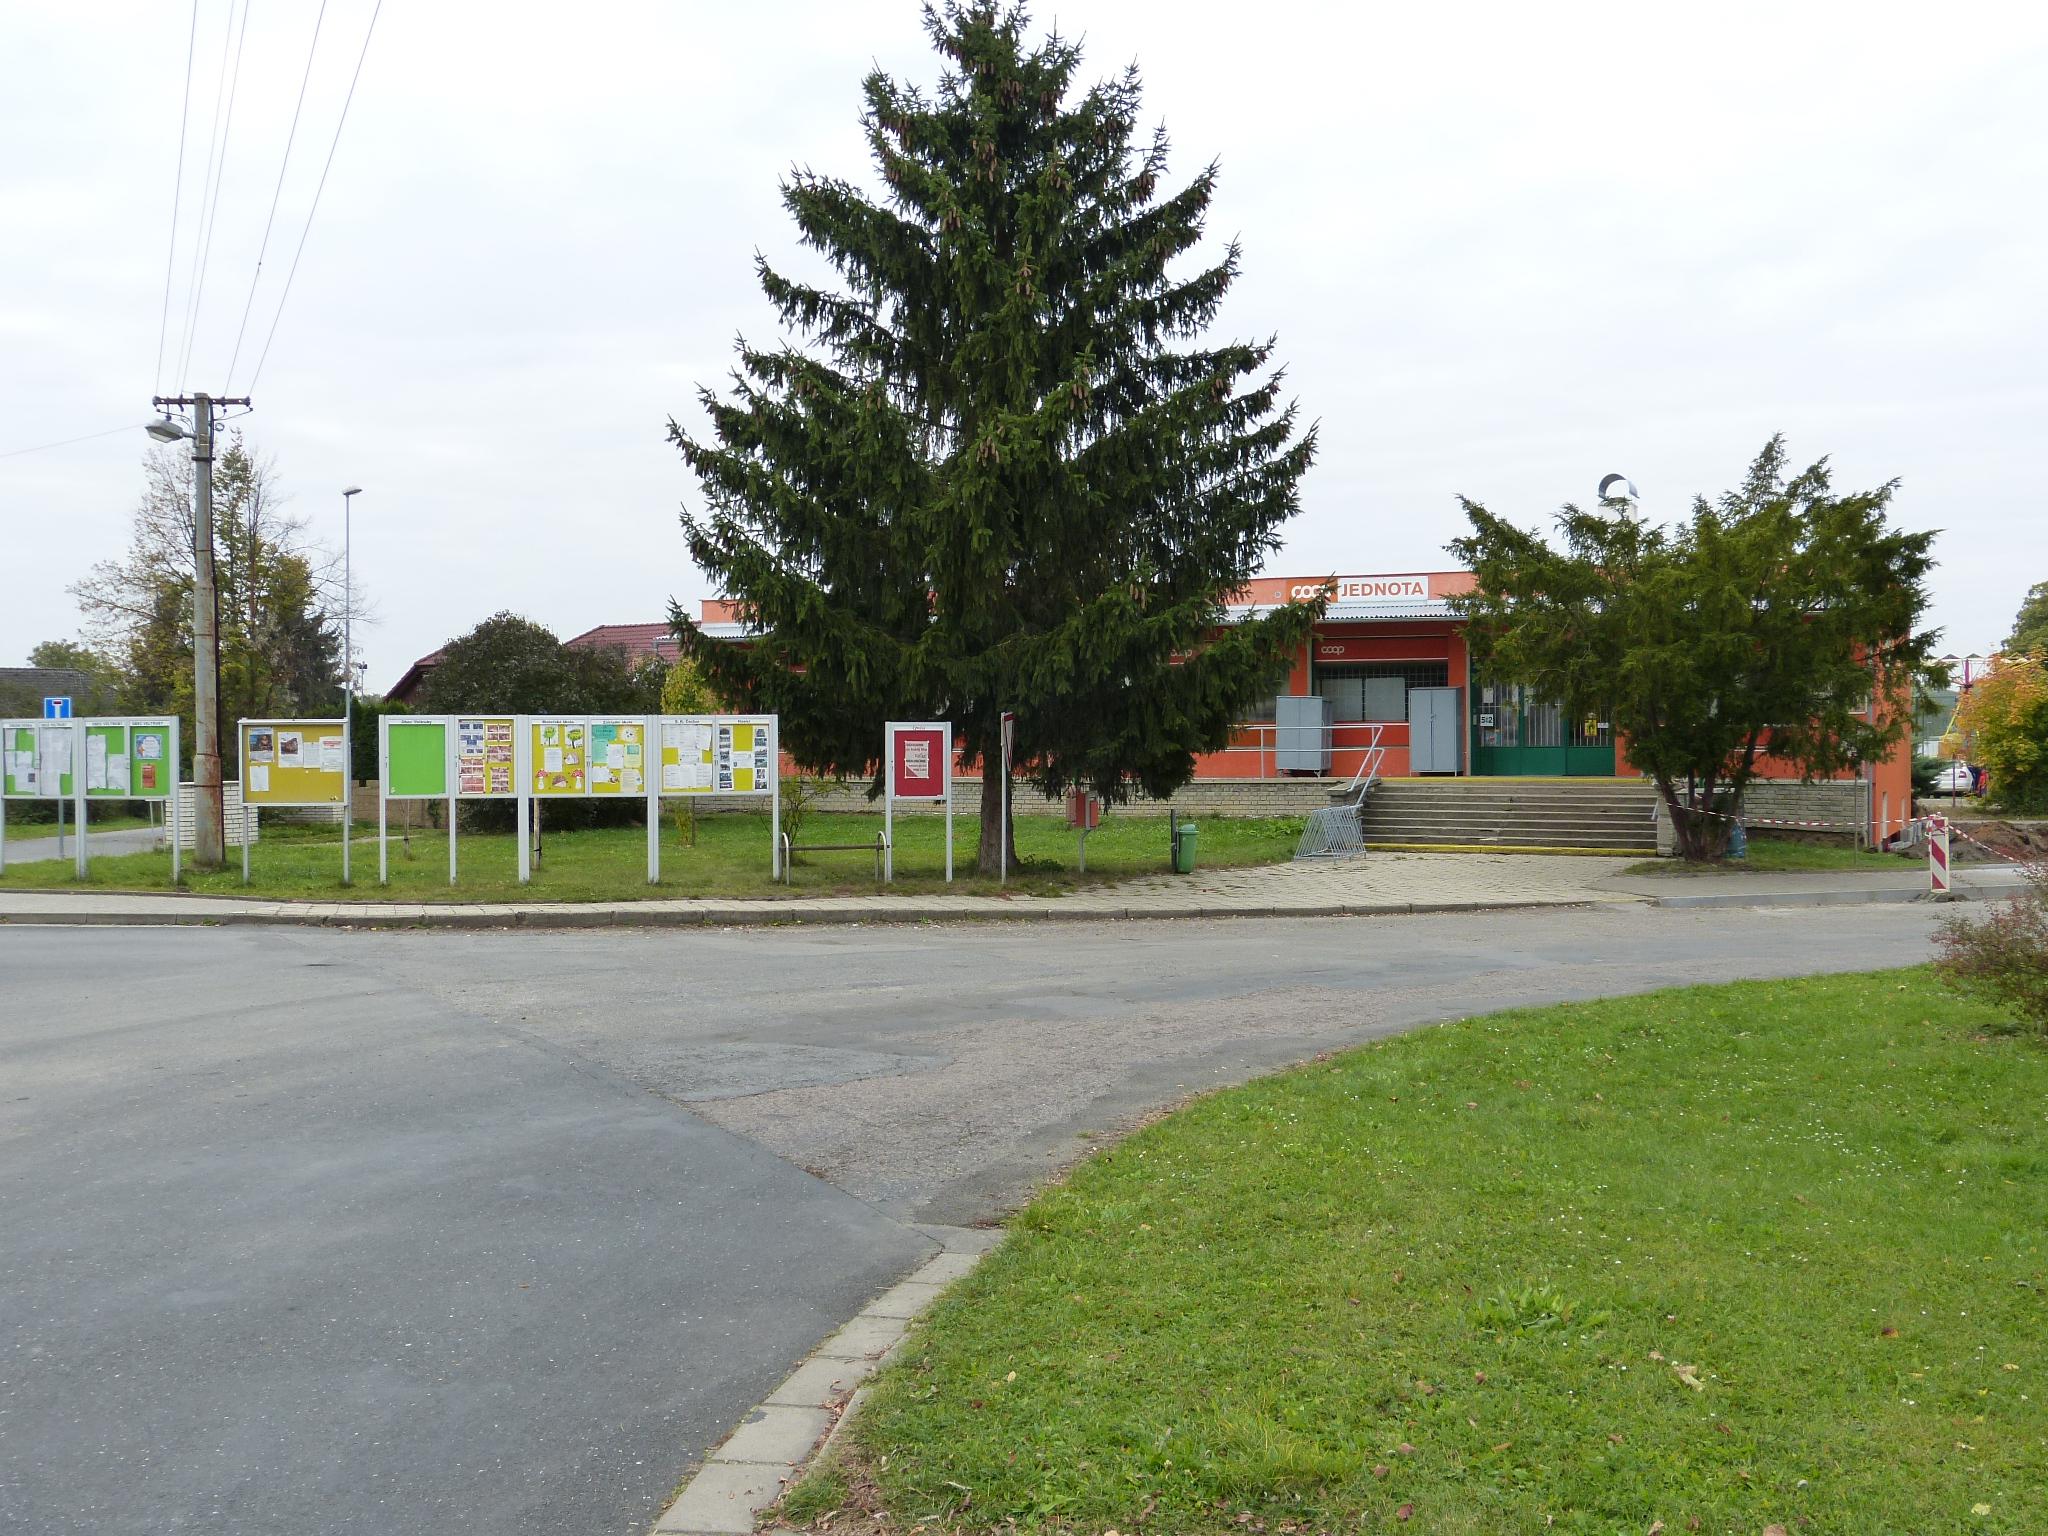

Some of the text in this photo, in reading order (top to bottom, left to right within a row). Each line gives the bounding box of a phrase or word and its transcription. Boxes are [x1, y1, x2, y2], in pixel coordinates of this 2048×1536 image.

[1291, 582, 1424, 599] coo JEDNOTA
[1321, 646, 1345, 655] coop
